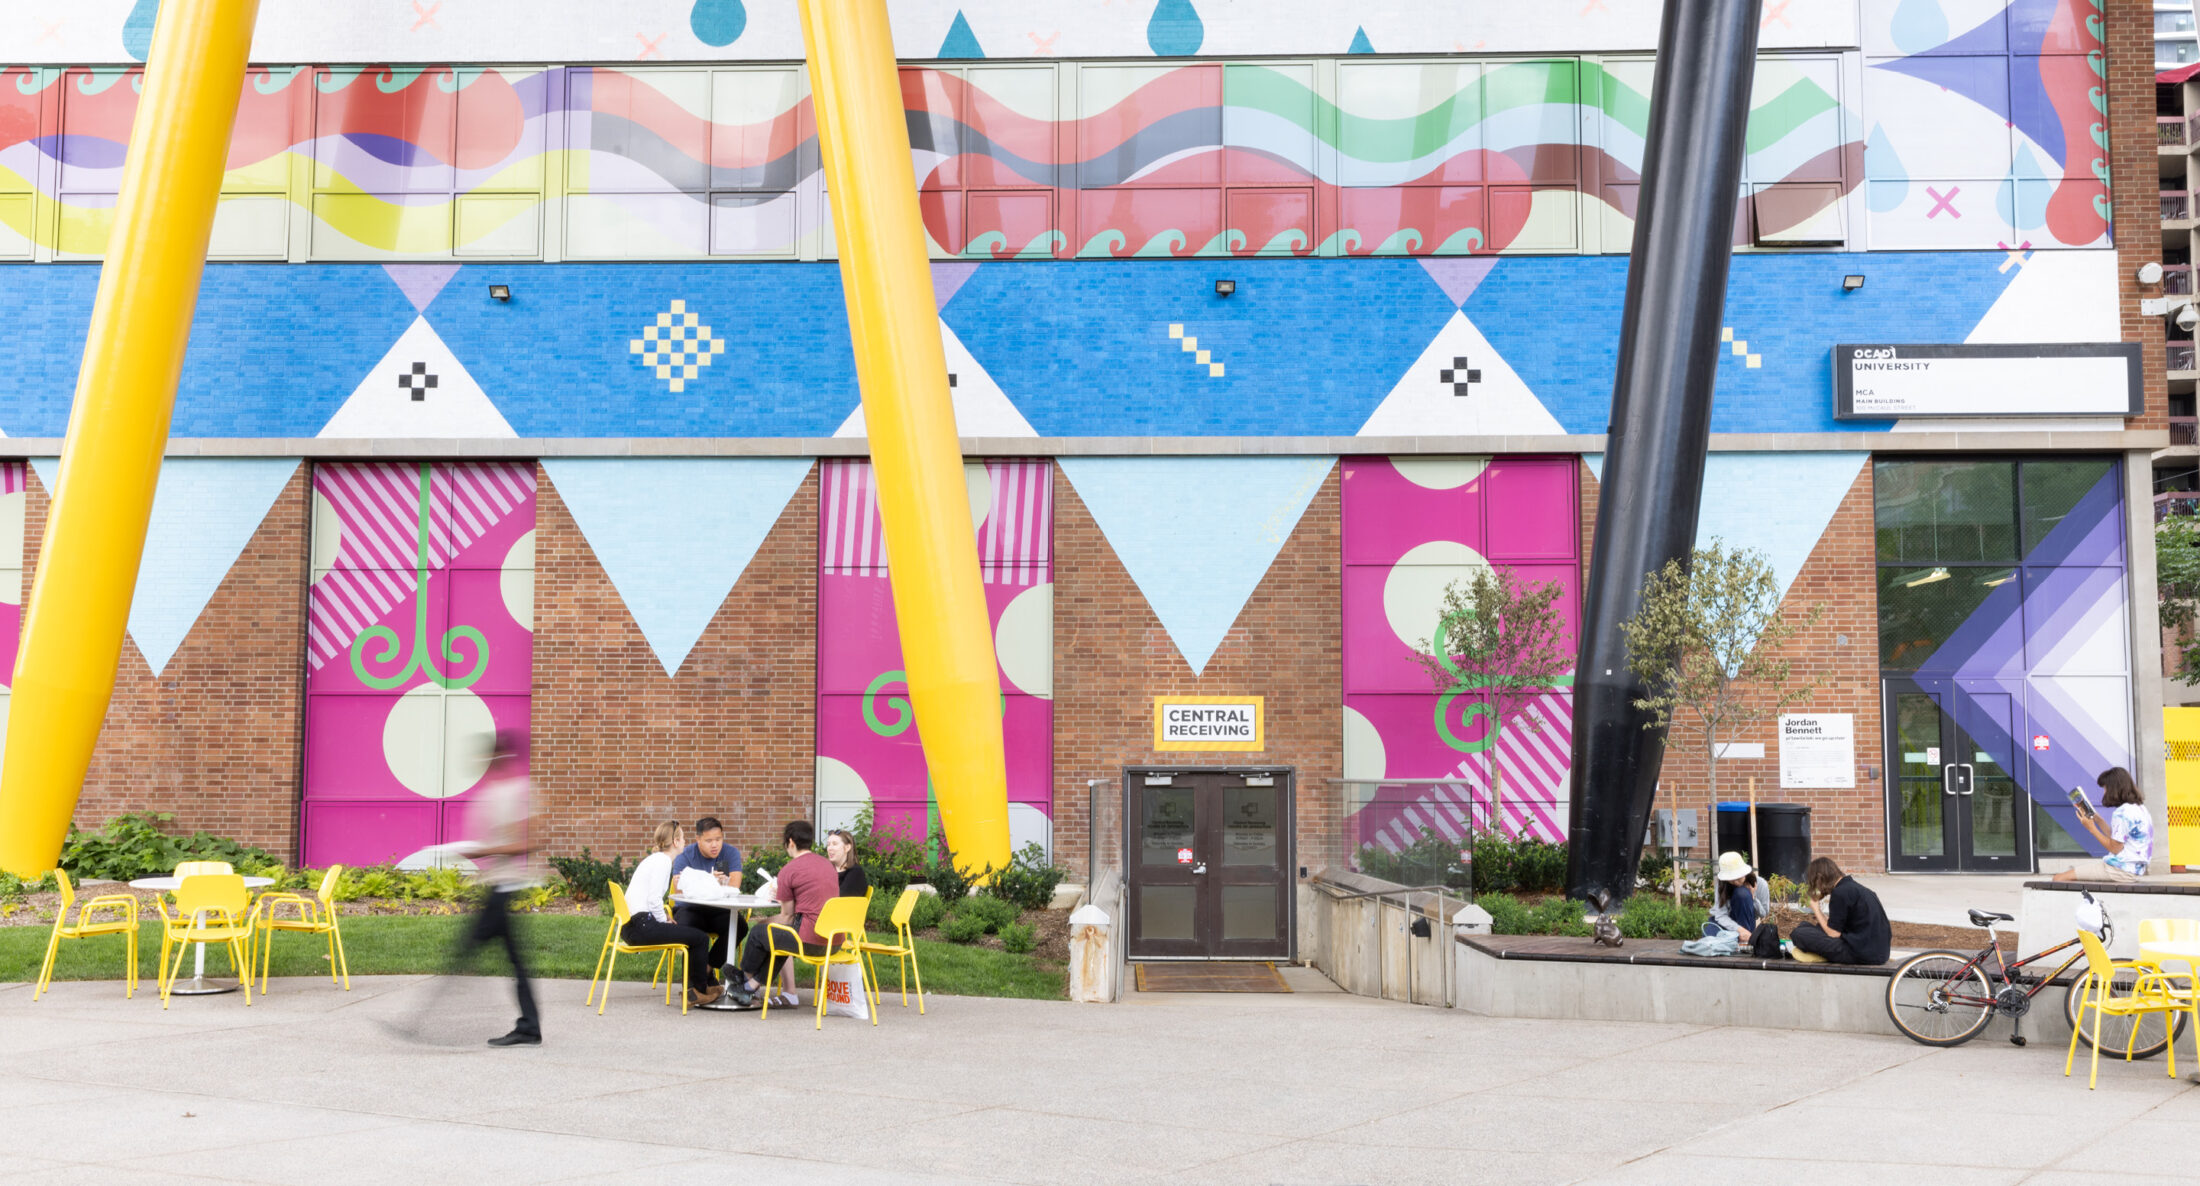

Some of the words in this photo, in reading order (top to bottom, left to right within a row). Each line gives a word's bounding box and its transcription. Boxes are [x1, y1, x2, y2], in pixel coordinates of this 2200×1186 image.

[1855, 362, 1930, 371] UNIVERSITY
[1169, 709, 1250, 722] CENTRAL
[1785, 718, 1818, 726] Jordan
[1169, 725, 1250, 736] RECEIVING
